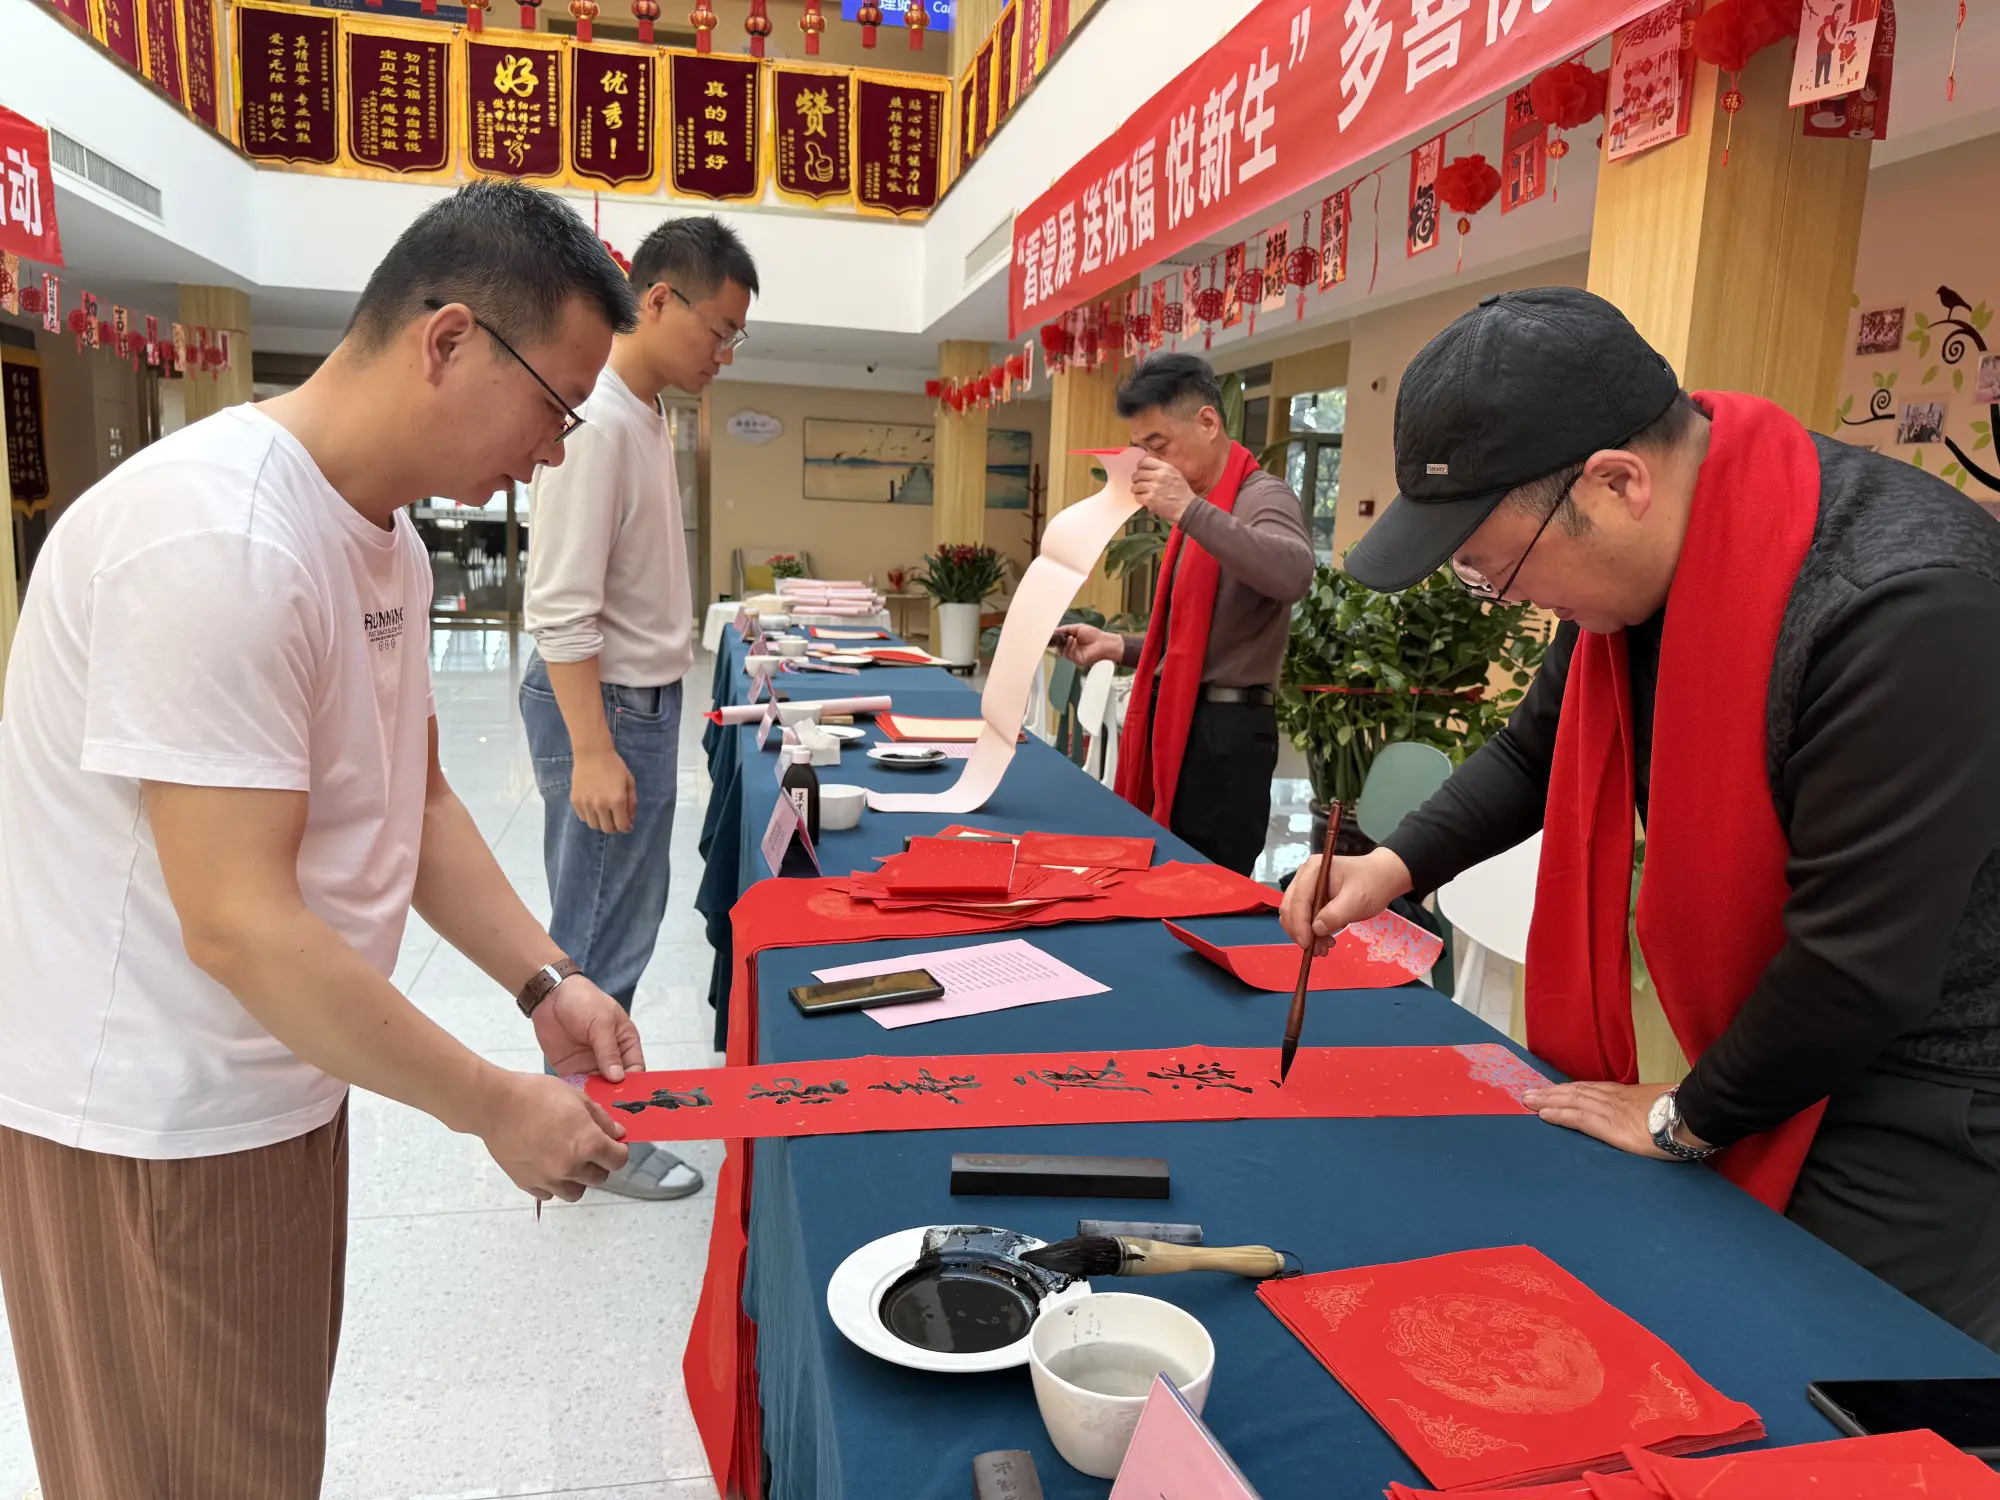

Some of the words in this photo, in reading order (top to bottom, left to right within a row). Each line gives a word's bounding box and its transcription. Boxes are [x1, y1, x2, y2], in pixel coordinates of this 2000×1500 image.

[494, 54, 539, 97] 好
[795, 87, 835, 138] 赞
[704, 80, 728, 170] 真的很好
[1079, 137, 1156, 277] 送祝福
[1337, 0, 1548, 132] 多喜
[0, 147, 43, 236] 动
[1409, 182, 1439, 248] 福
